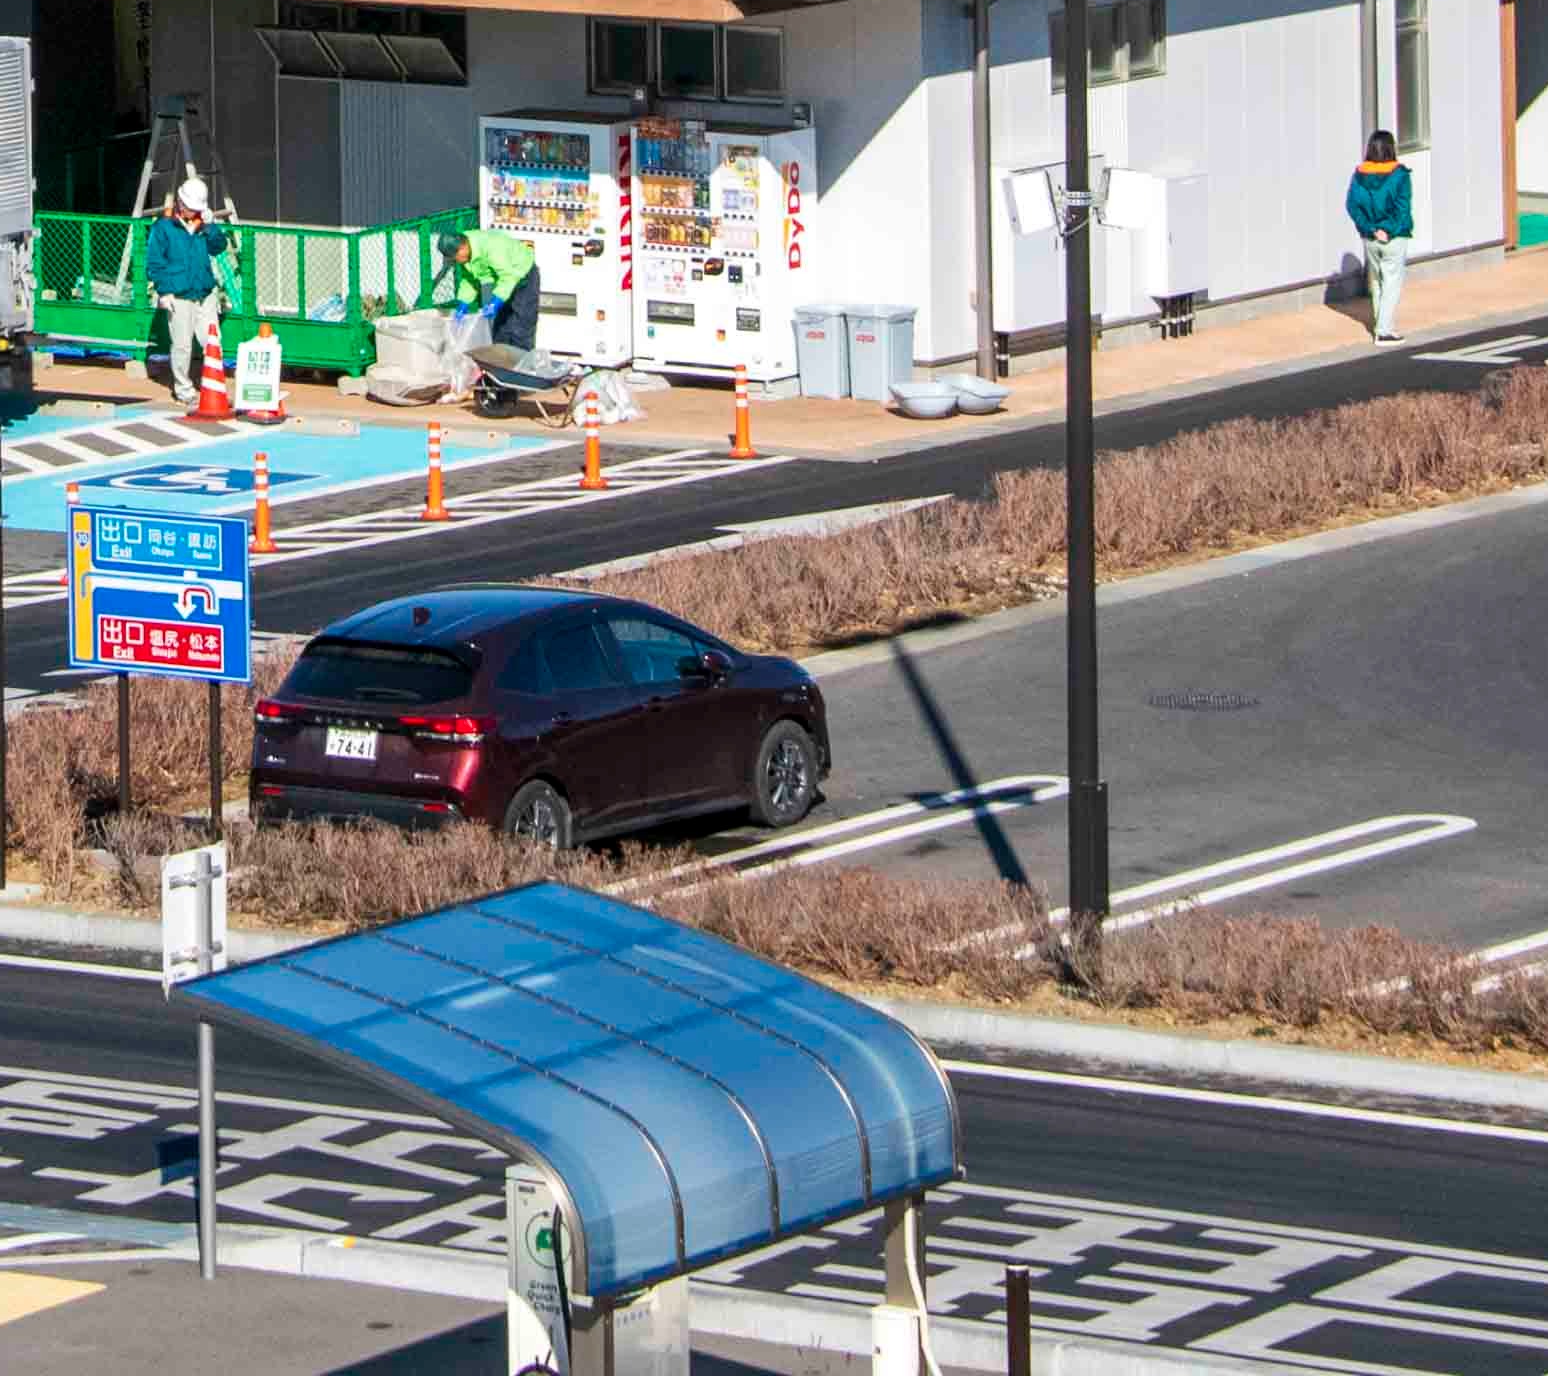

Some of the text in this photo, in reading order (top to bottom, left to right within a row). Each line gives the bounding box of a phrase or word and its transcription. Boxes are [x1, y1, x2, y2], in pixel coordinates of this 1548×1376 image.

[101, 519, 142, 545] 出口
[111, 544, 133, 560] Exit
[102, 618, 220, 652] 出口 塩尻・松本
[112, 645, 135, 661] Exit
[336, 737, 373, 758] 74-41
